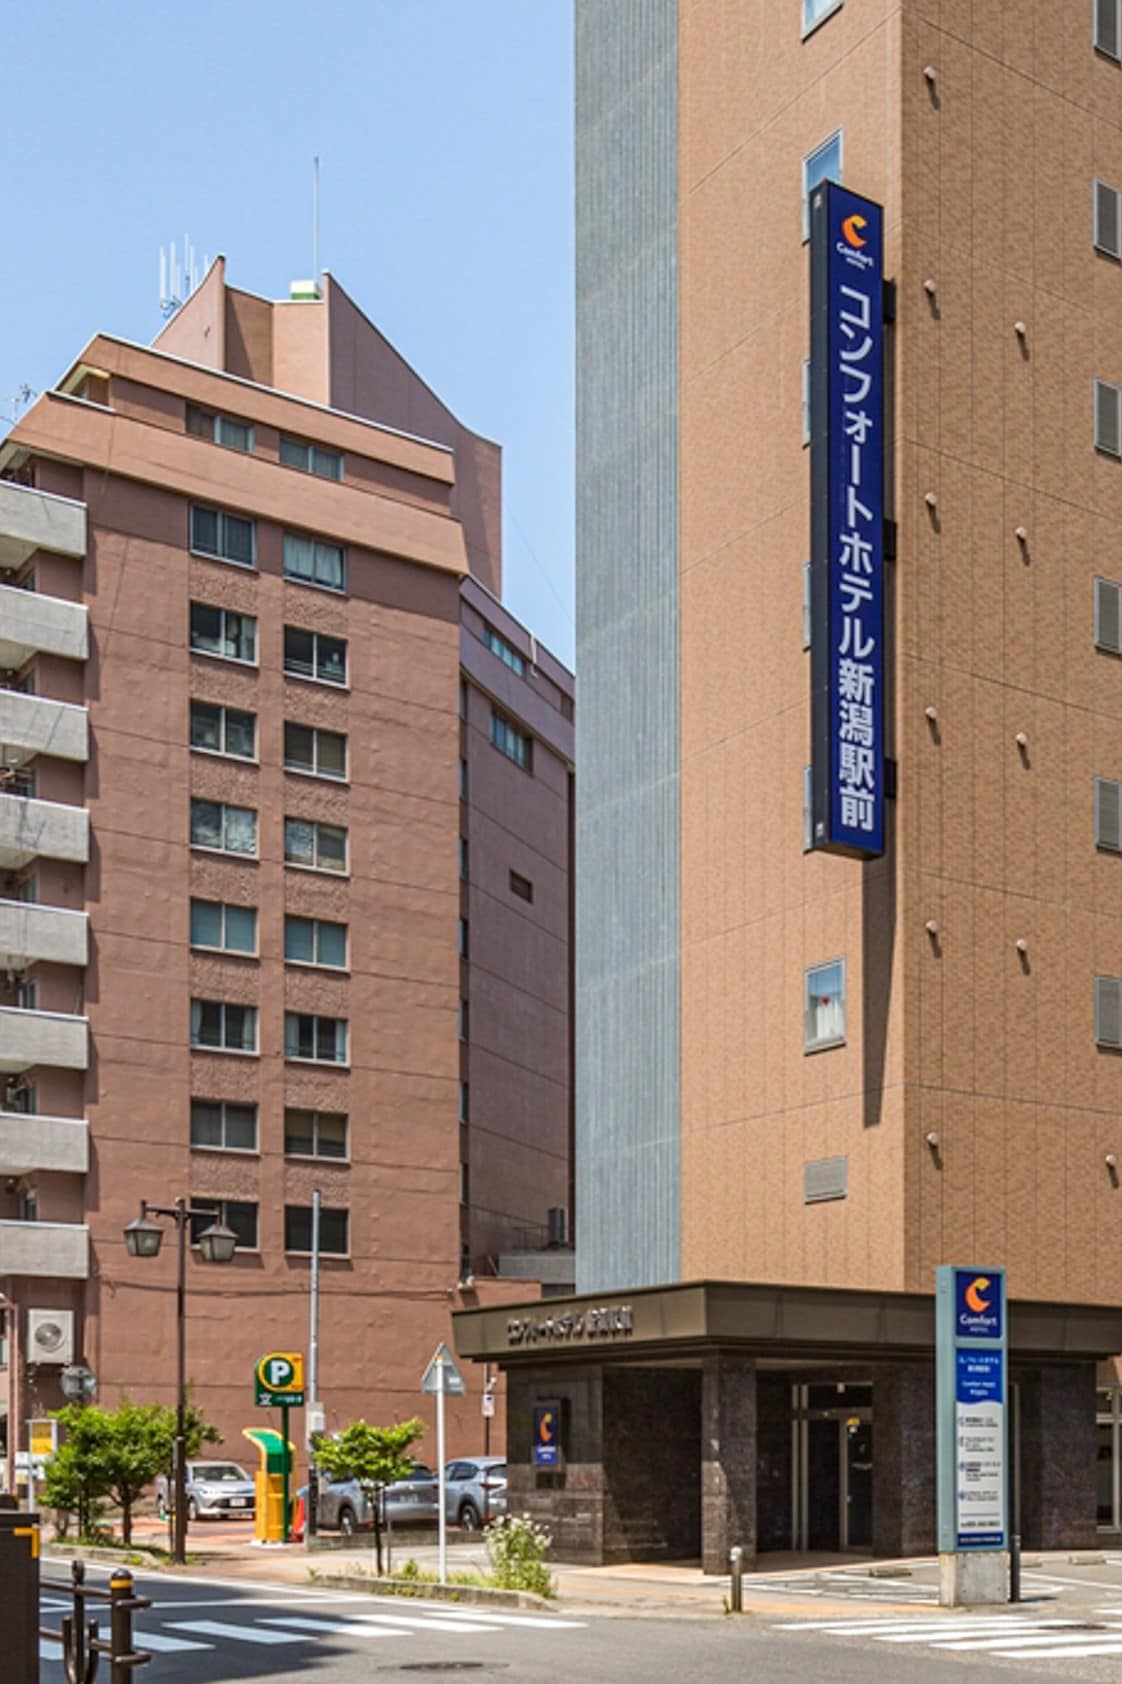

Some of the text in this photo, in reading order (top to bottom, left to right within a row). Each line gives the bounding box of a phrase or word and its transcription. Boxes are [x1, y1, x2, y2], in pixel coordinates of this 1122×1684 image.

[839, 284, 874, 832] コンフォートホテル新潟駅前
[960, 1312, 998, 1327] Comfort
[271, 1360, 290, 1385] P
